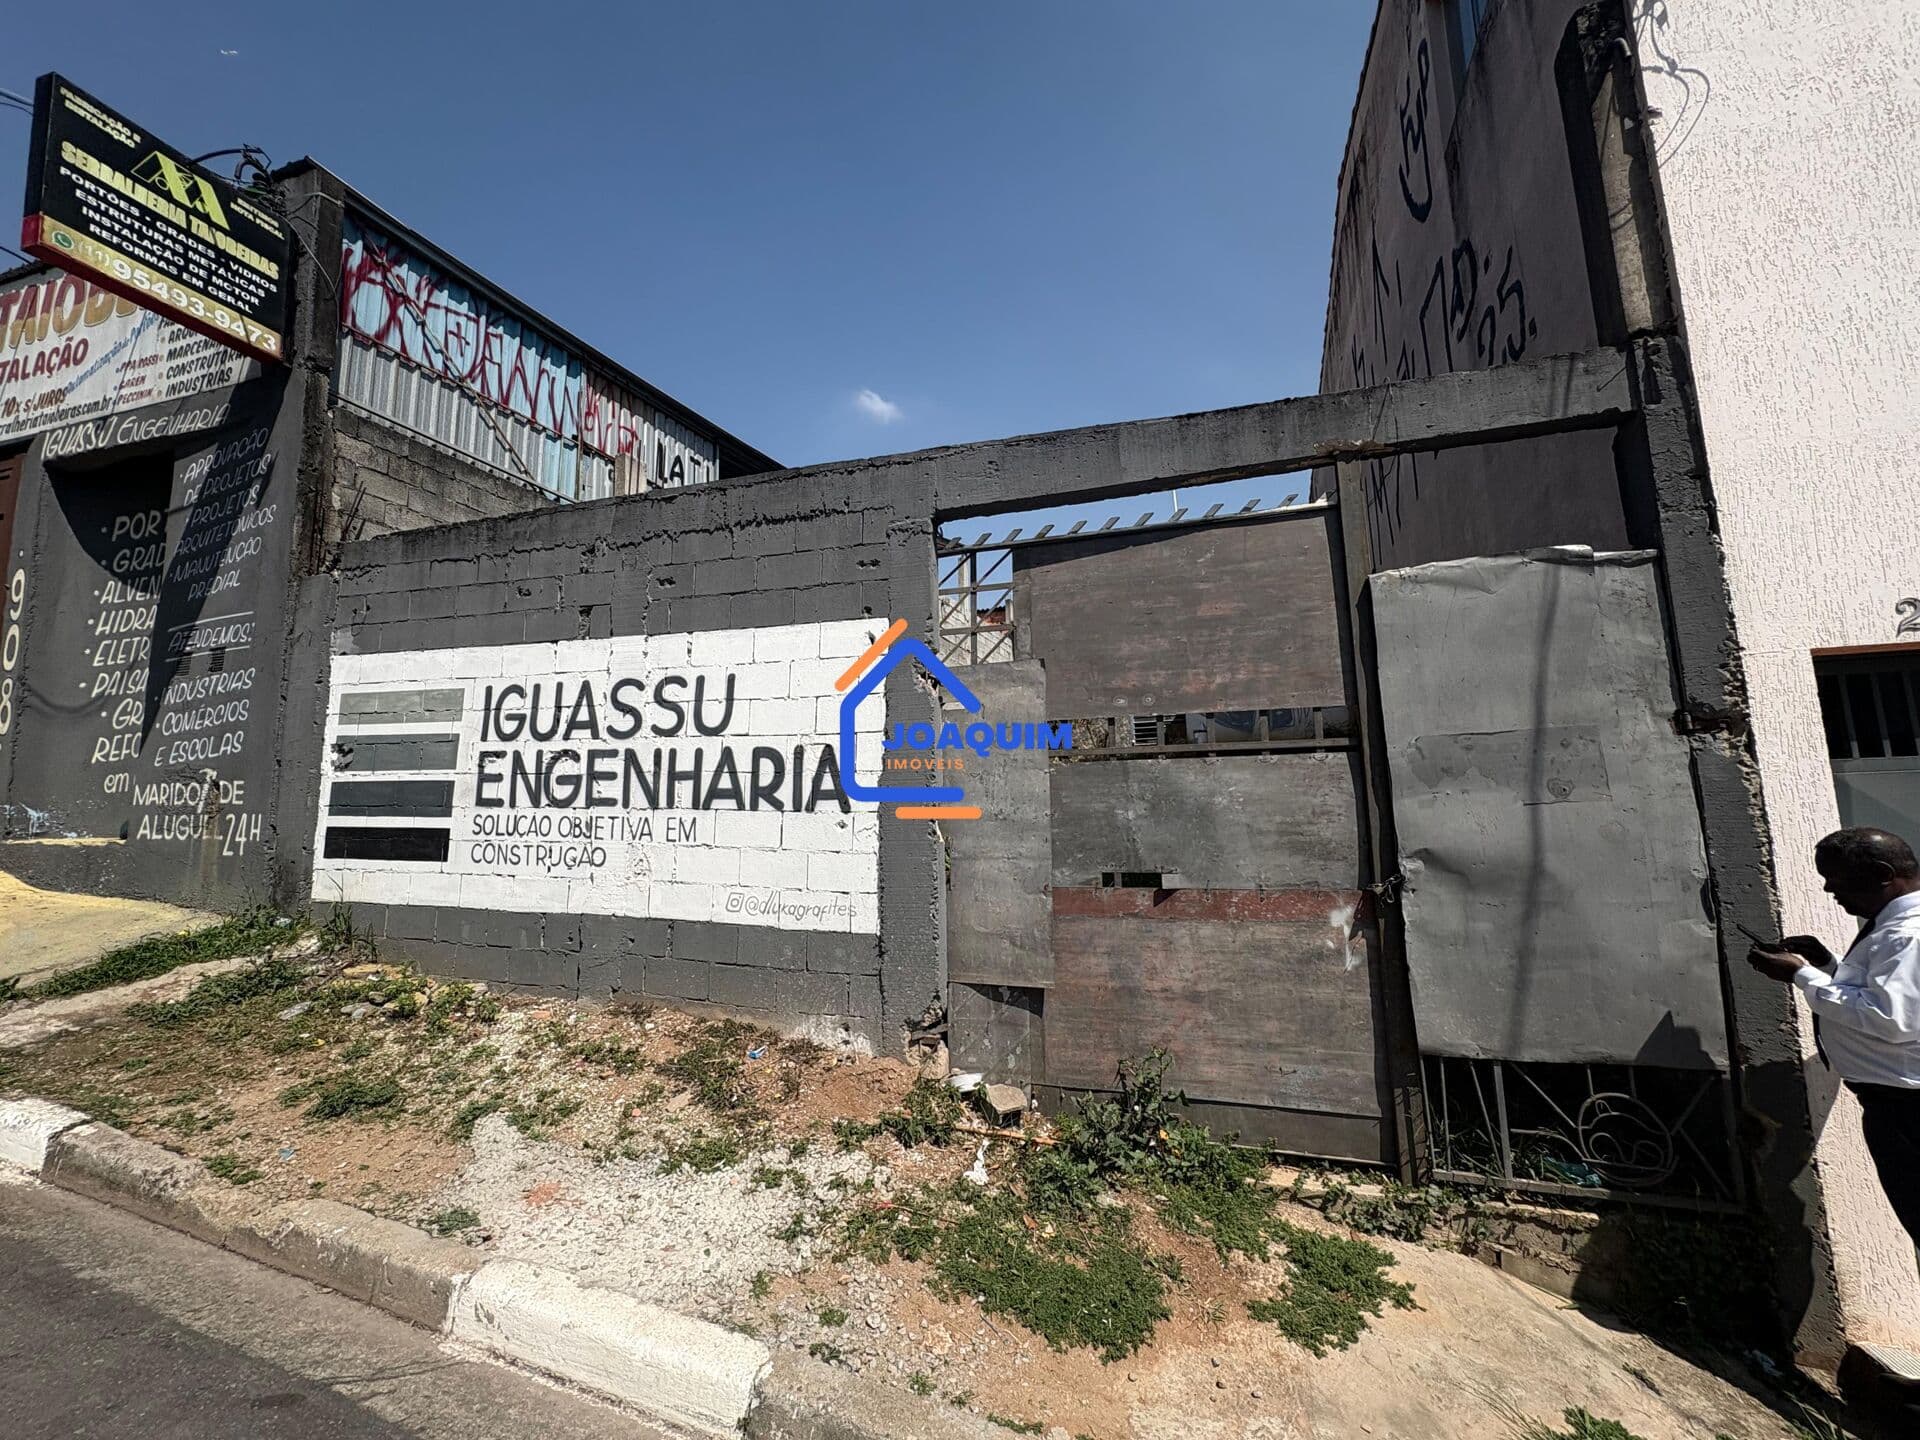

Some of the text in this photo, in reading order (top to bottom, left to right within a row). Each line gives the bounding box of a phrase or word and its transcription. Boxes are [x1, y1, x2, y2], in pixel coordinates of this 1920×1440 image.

[59, 163, 277, 294] PORTÕES GRADES VIDROS
[74, 187, 266, 298] ESTRUTURAS METÁLICAS
[81, 203, 259, 306] INSTALAÇÃO DE MOTOR
[89, 222, 253, 314] REFORMAS EM GERAL
[41, 415, 117, 460] IGUASSU
[184, 453, 271, 507] DE PROJETOS
[191, 484, 260, 528] PROJETOS
[187, 569, 241, 602] PREDIAL
[164, 667, 256, 705] INDÚSTRIAS
[480, 673, 736, 743] IGUASSU
[162, 699, 250, 736] COMÉRCIOS
[154, 730, 244, 767] E ESCOLAS
[104, 772, 129, 794] em
[133, 780, 245, 806] MARIDO DE
[475, 744, 852, 815] ENGENHARIA
[136, 813, 223, 841] ALUGUEL
[557, 815, 655, 842] OBJETIVA
[665, 816, 698, 843] EM
